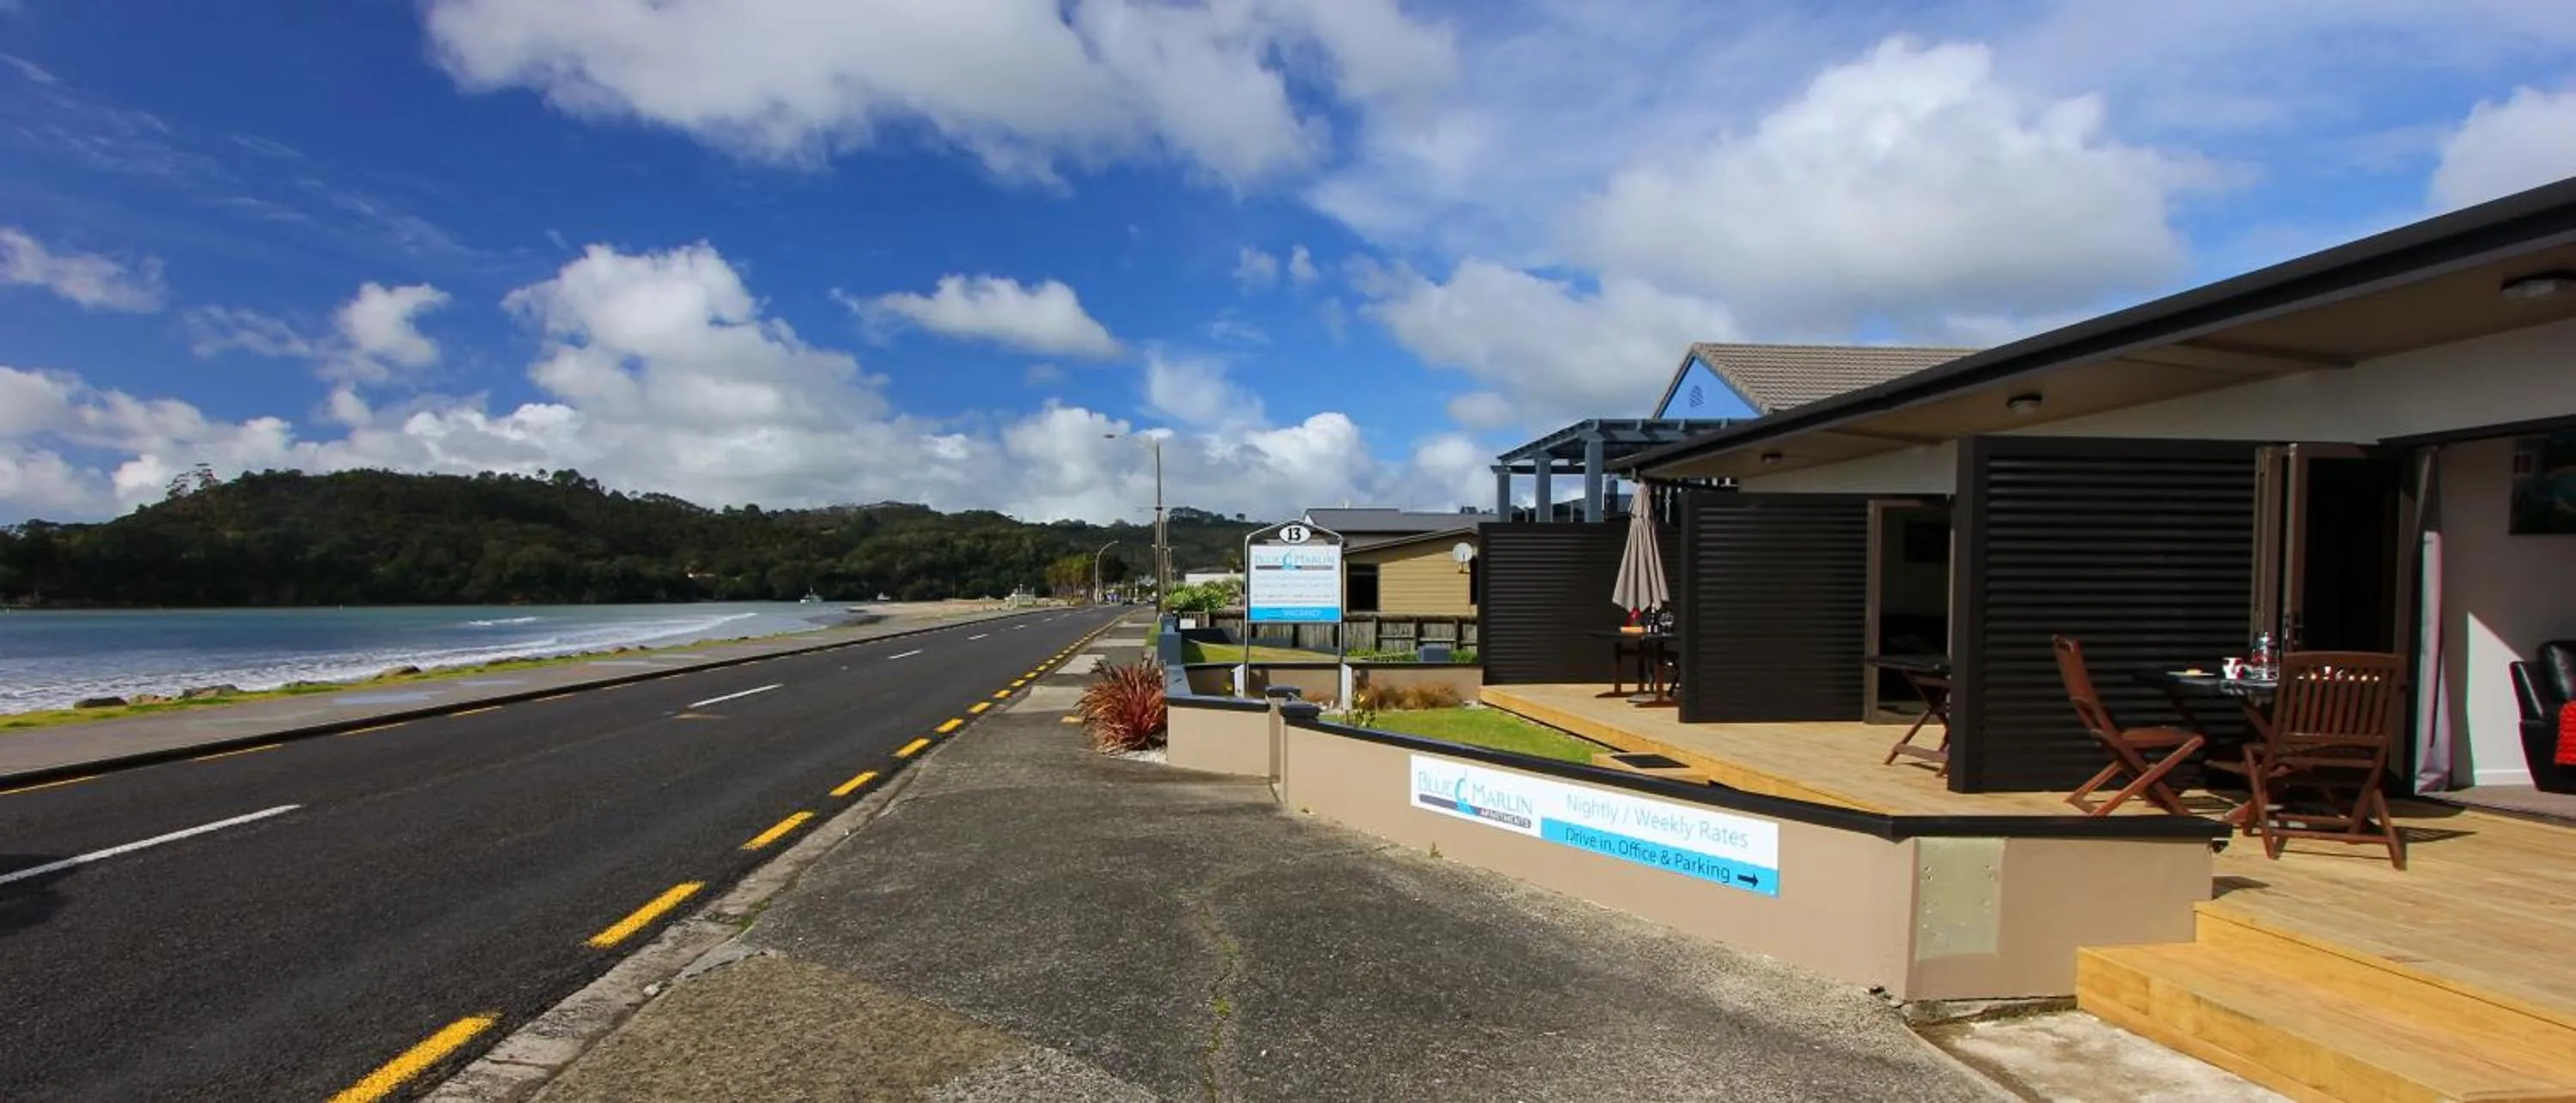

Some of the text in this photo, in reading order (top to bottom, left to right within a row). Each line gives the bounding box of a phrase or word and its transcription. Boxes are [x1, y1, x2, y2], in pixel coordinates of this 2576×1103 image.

[1288, 527, 1302, 540] 13
[1295, 554, 1335, 564] MARLIN
[1418, 770, 1534, 816] BLUE MARLIN
[1566, 794, 1619, 826] Nightly
[1634, 806, 1695, 841] Weekly
[1698, 820, 1750, 849] Rates
[1565, 827, 1597, 848] Drive
[1619, 839, 1656, 863] Office
[1660, 849, 1671, 865] &
[1675, 852, 1730, 883] Parking
